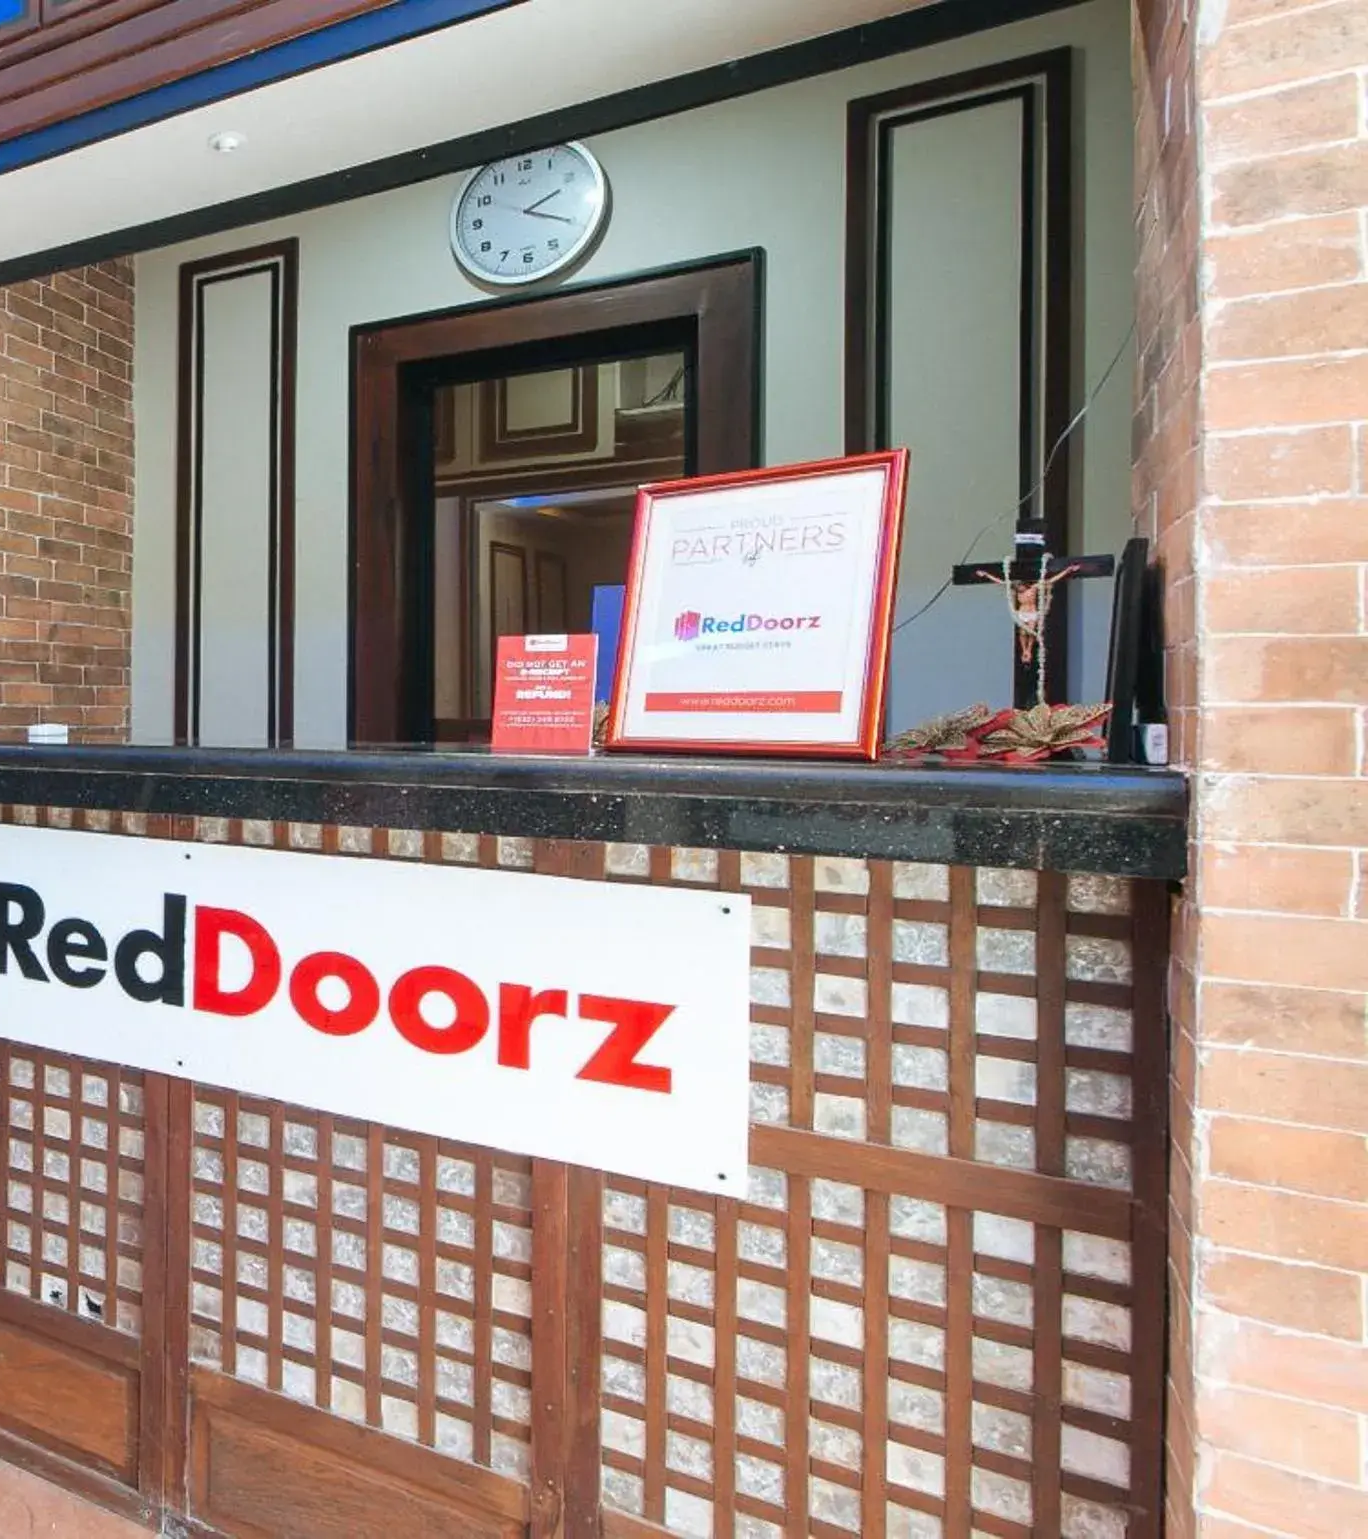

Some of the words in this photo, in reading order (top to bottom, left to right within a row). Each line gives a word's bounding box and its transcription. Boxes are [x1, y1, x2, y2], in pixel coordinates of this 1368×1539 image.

[517, 159, 532, 171] 12
[493, 174, 505, 185] 11
[477, 195, 492, 208] 10
[472, 218, 484, 230] 9
[481, 240, 492, 252] 8
[500, 250, 510, 262] 7
[522, 253, 534, 263] 6
[672, 522, 846, 560] PARTNERS
[701, 614, 822, 634] RedDoorz
